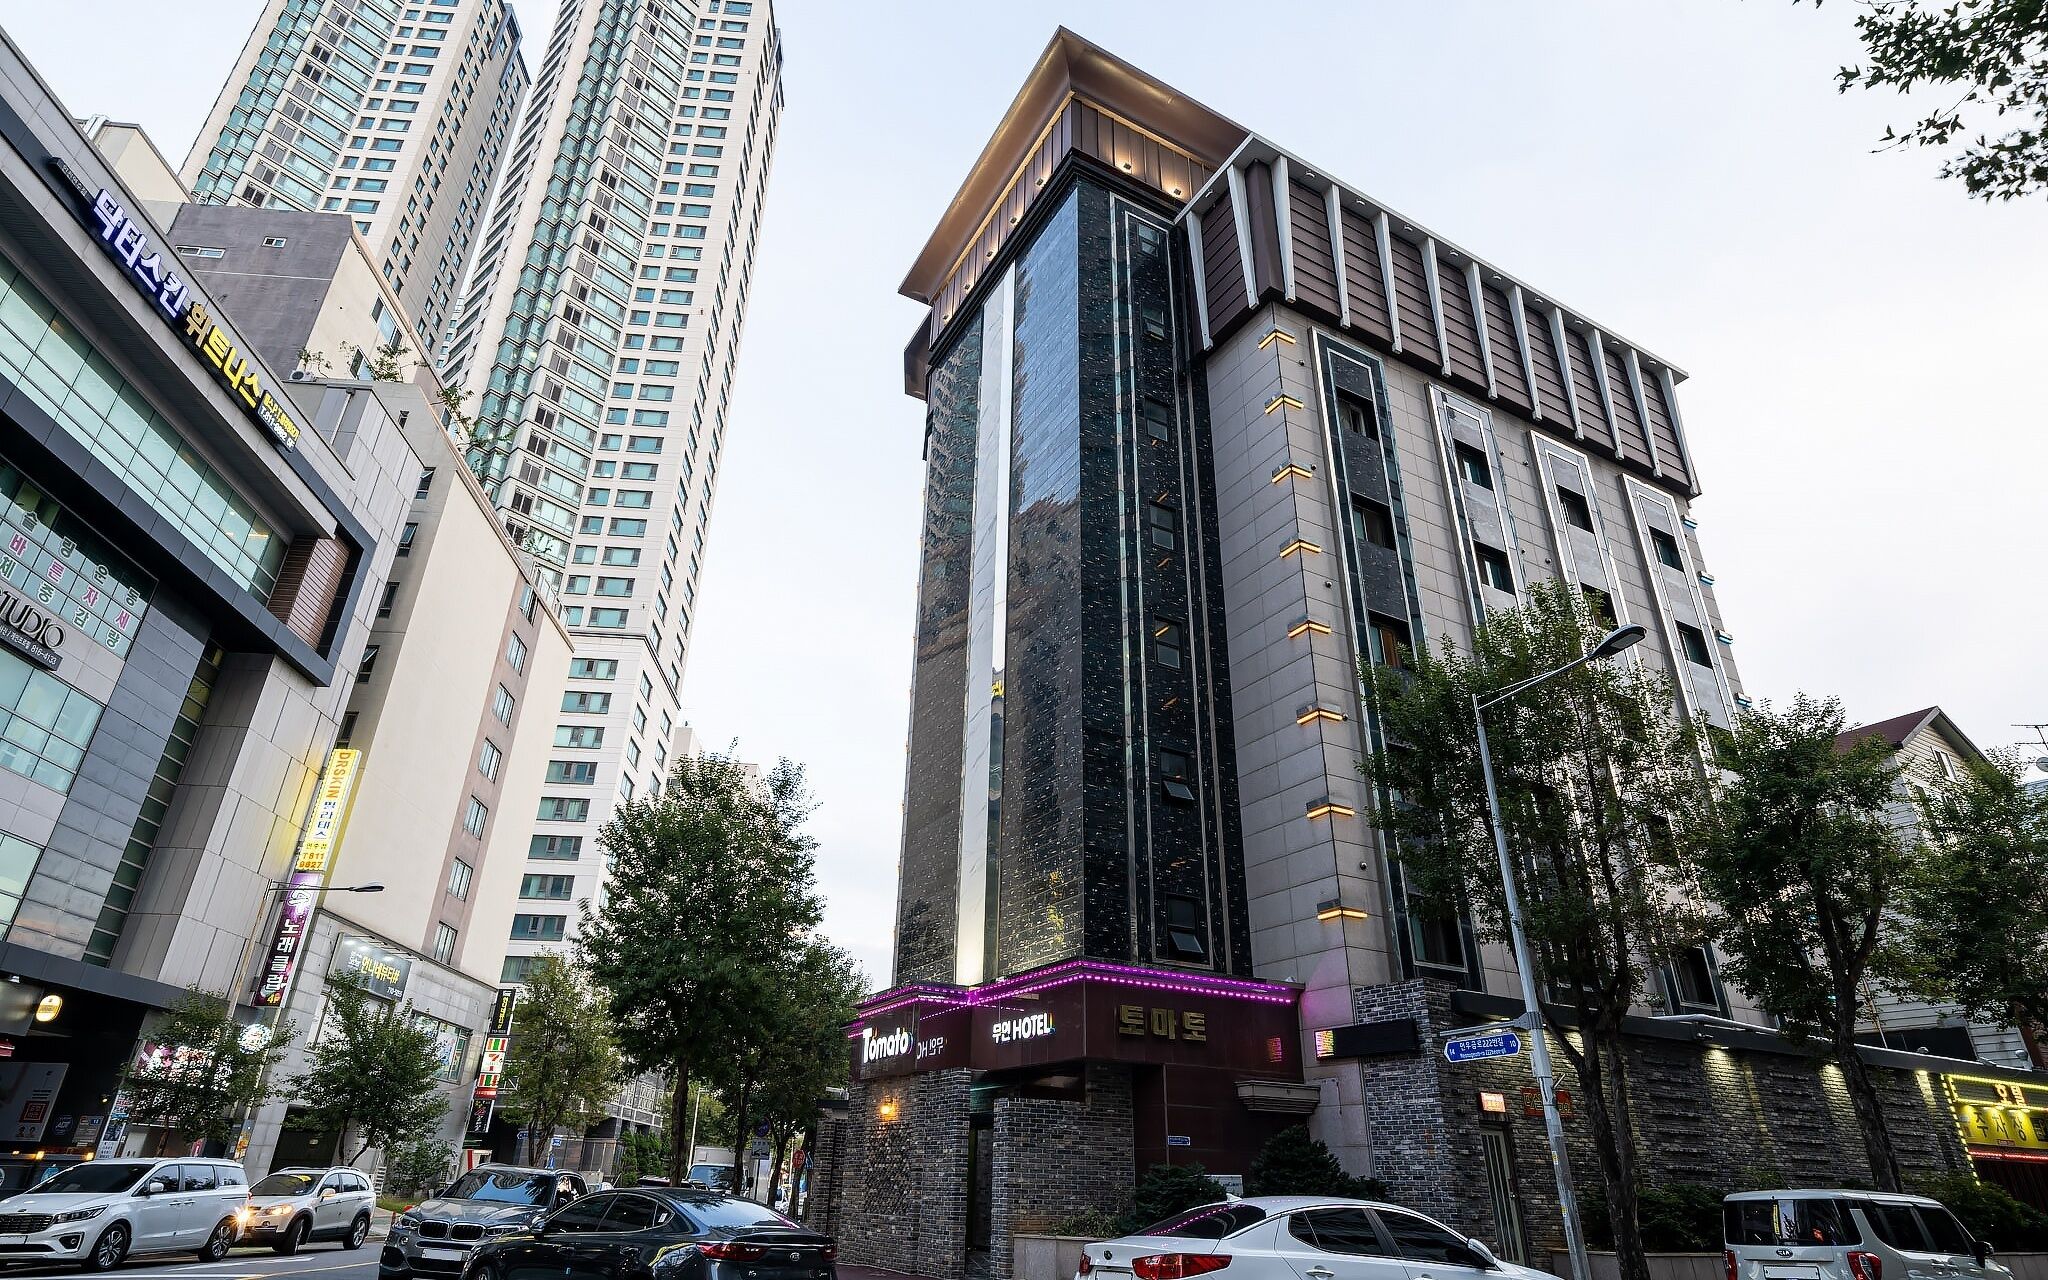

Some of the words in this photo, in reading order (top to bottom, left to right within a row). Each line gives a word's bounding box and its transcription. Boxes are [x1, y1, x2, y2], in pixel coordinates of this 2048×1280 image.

[93, 190, 190, 317] 닥터스킨
[184, 302, 263, 409] 휘트니스
[0, 587, 66, 650] TUDIO
[325, 751, 352, 799] DRSKIN
[312, 800, 337, 840] 필라테스
[264, 919, 302, 992] 노래클럽
[266, 994, 280, 1005] 4F
[992, 1022, 1011, 1043] 무인
[1012, 1013, 1051, 1039] HOTEL
[1118, 1004, 1208, 1043] 토마토
[862, 1027, 909, 1063] Tomato
[1995, 1083, 2027, 1107] 호텔
